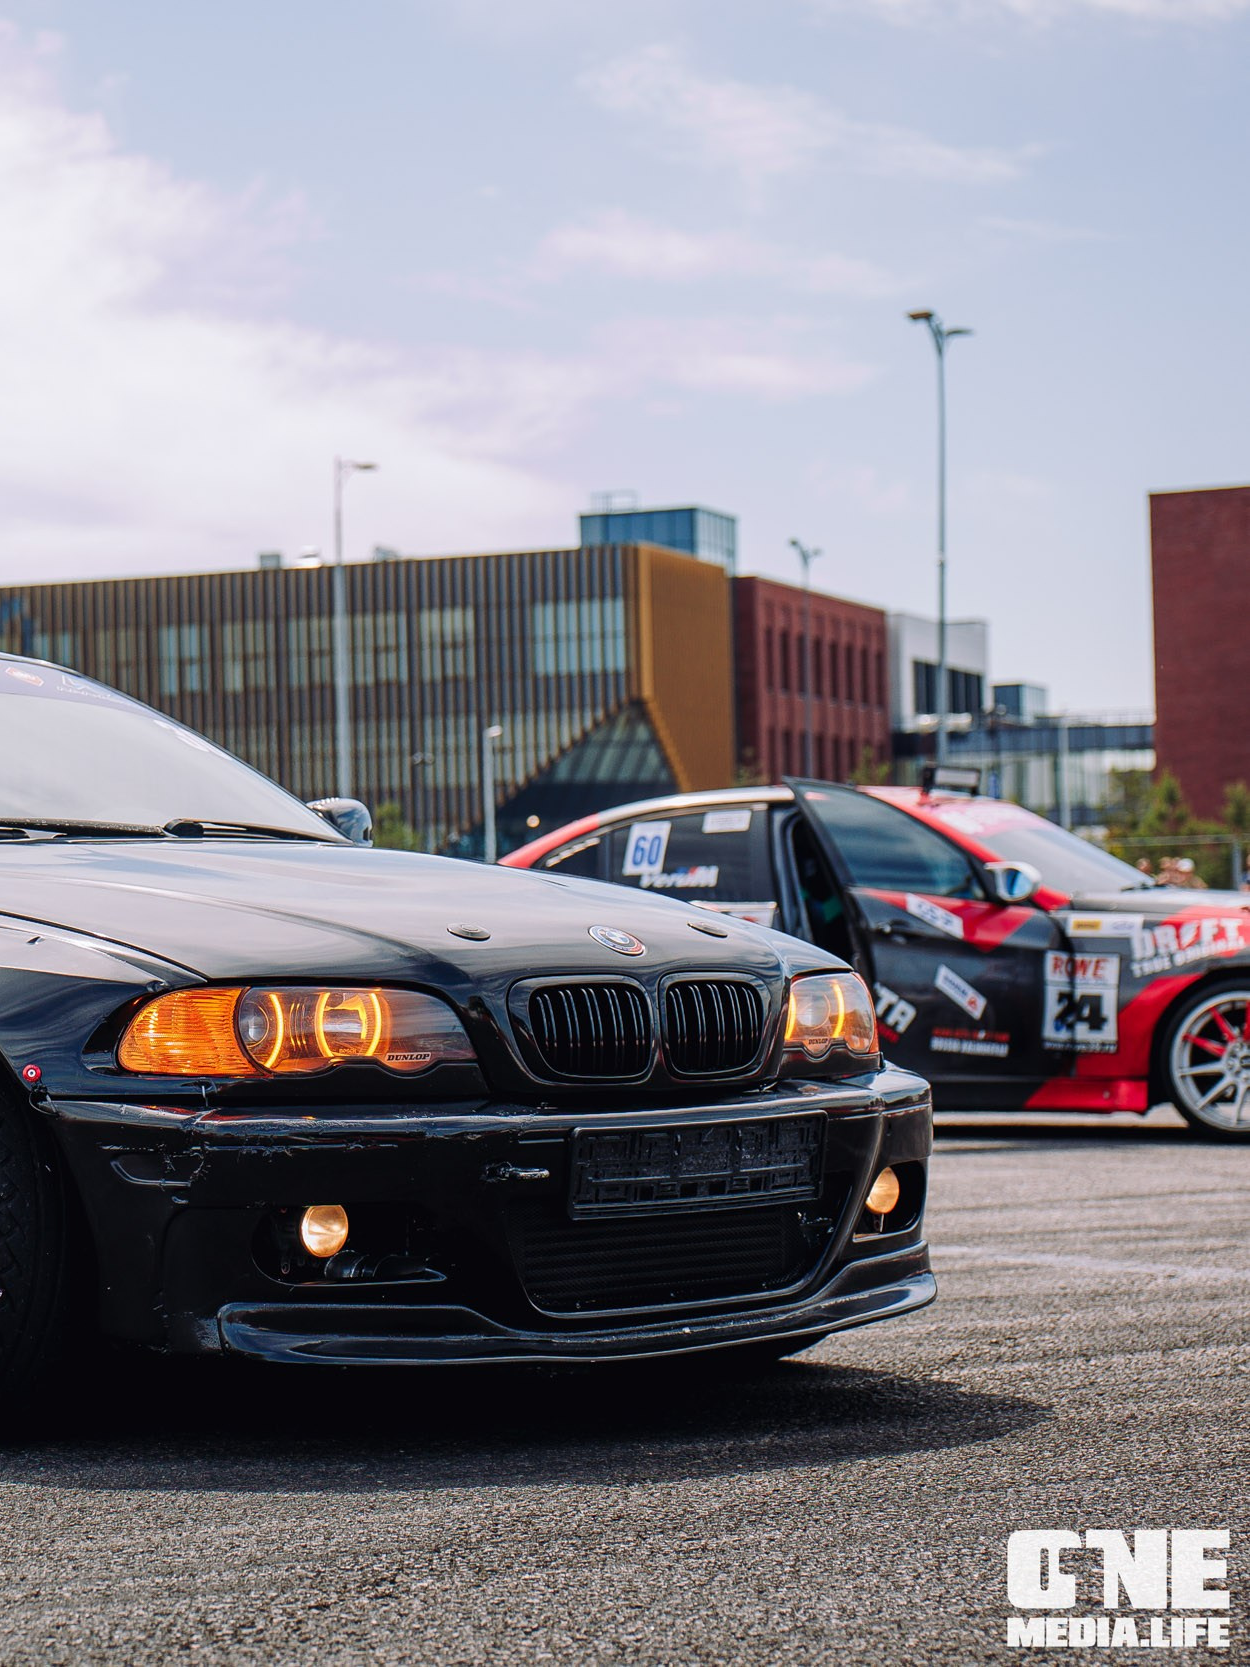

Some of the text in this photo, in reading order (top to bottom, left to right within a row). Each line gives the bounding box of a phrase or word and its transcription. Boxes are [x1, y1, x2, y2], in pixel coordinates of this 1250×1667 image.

[632, 836, 662, 867] 60
[1052, 955, 1108, 979] ROWE
[1054, 991, 1108, 1031] 24
[386, 1053, 431, 1061] DUNLOP
